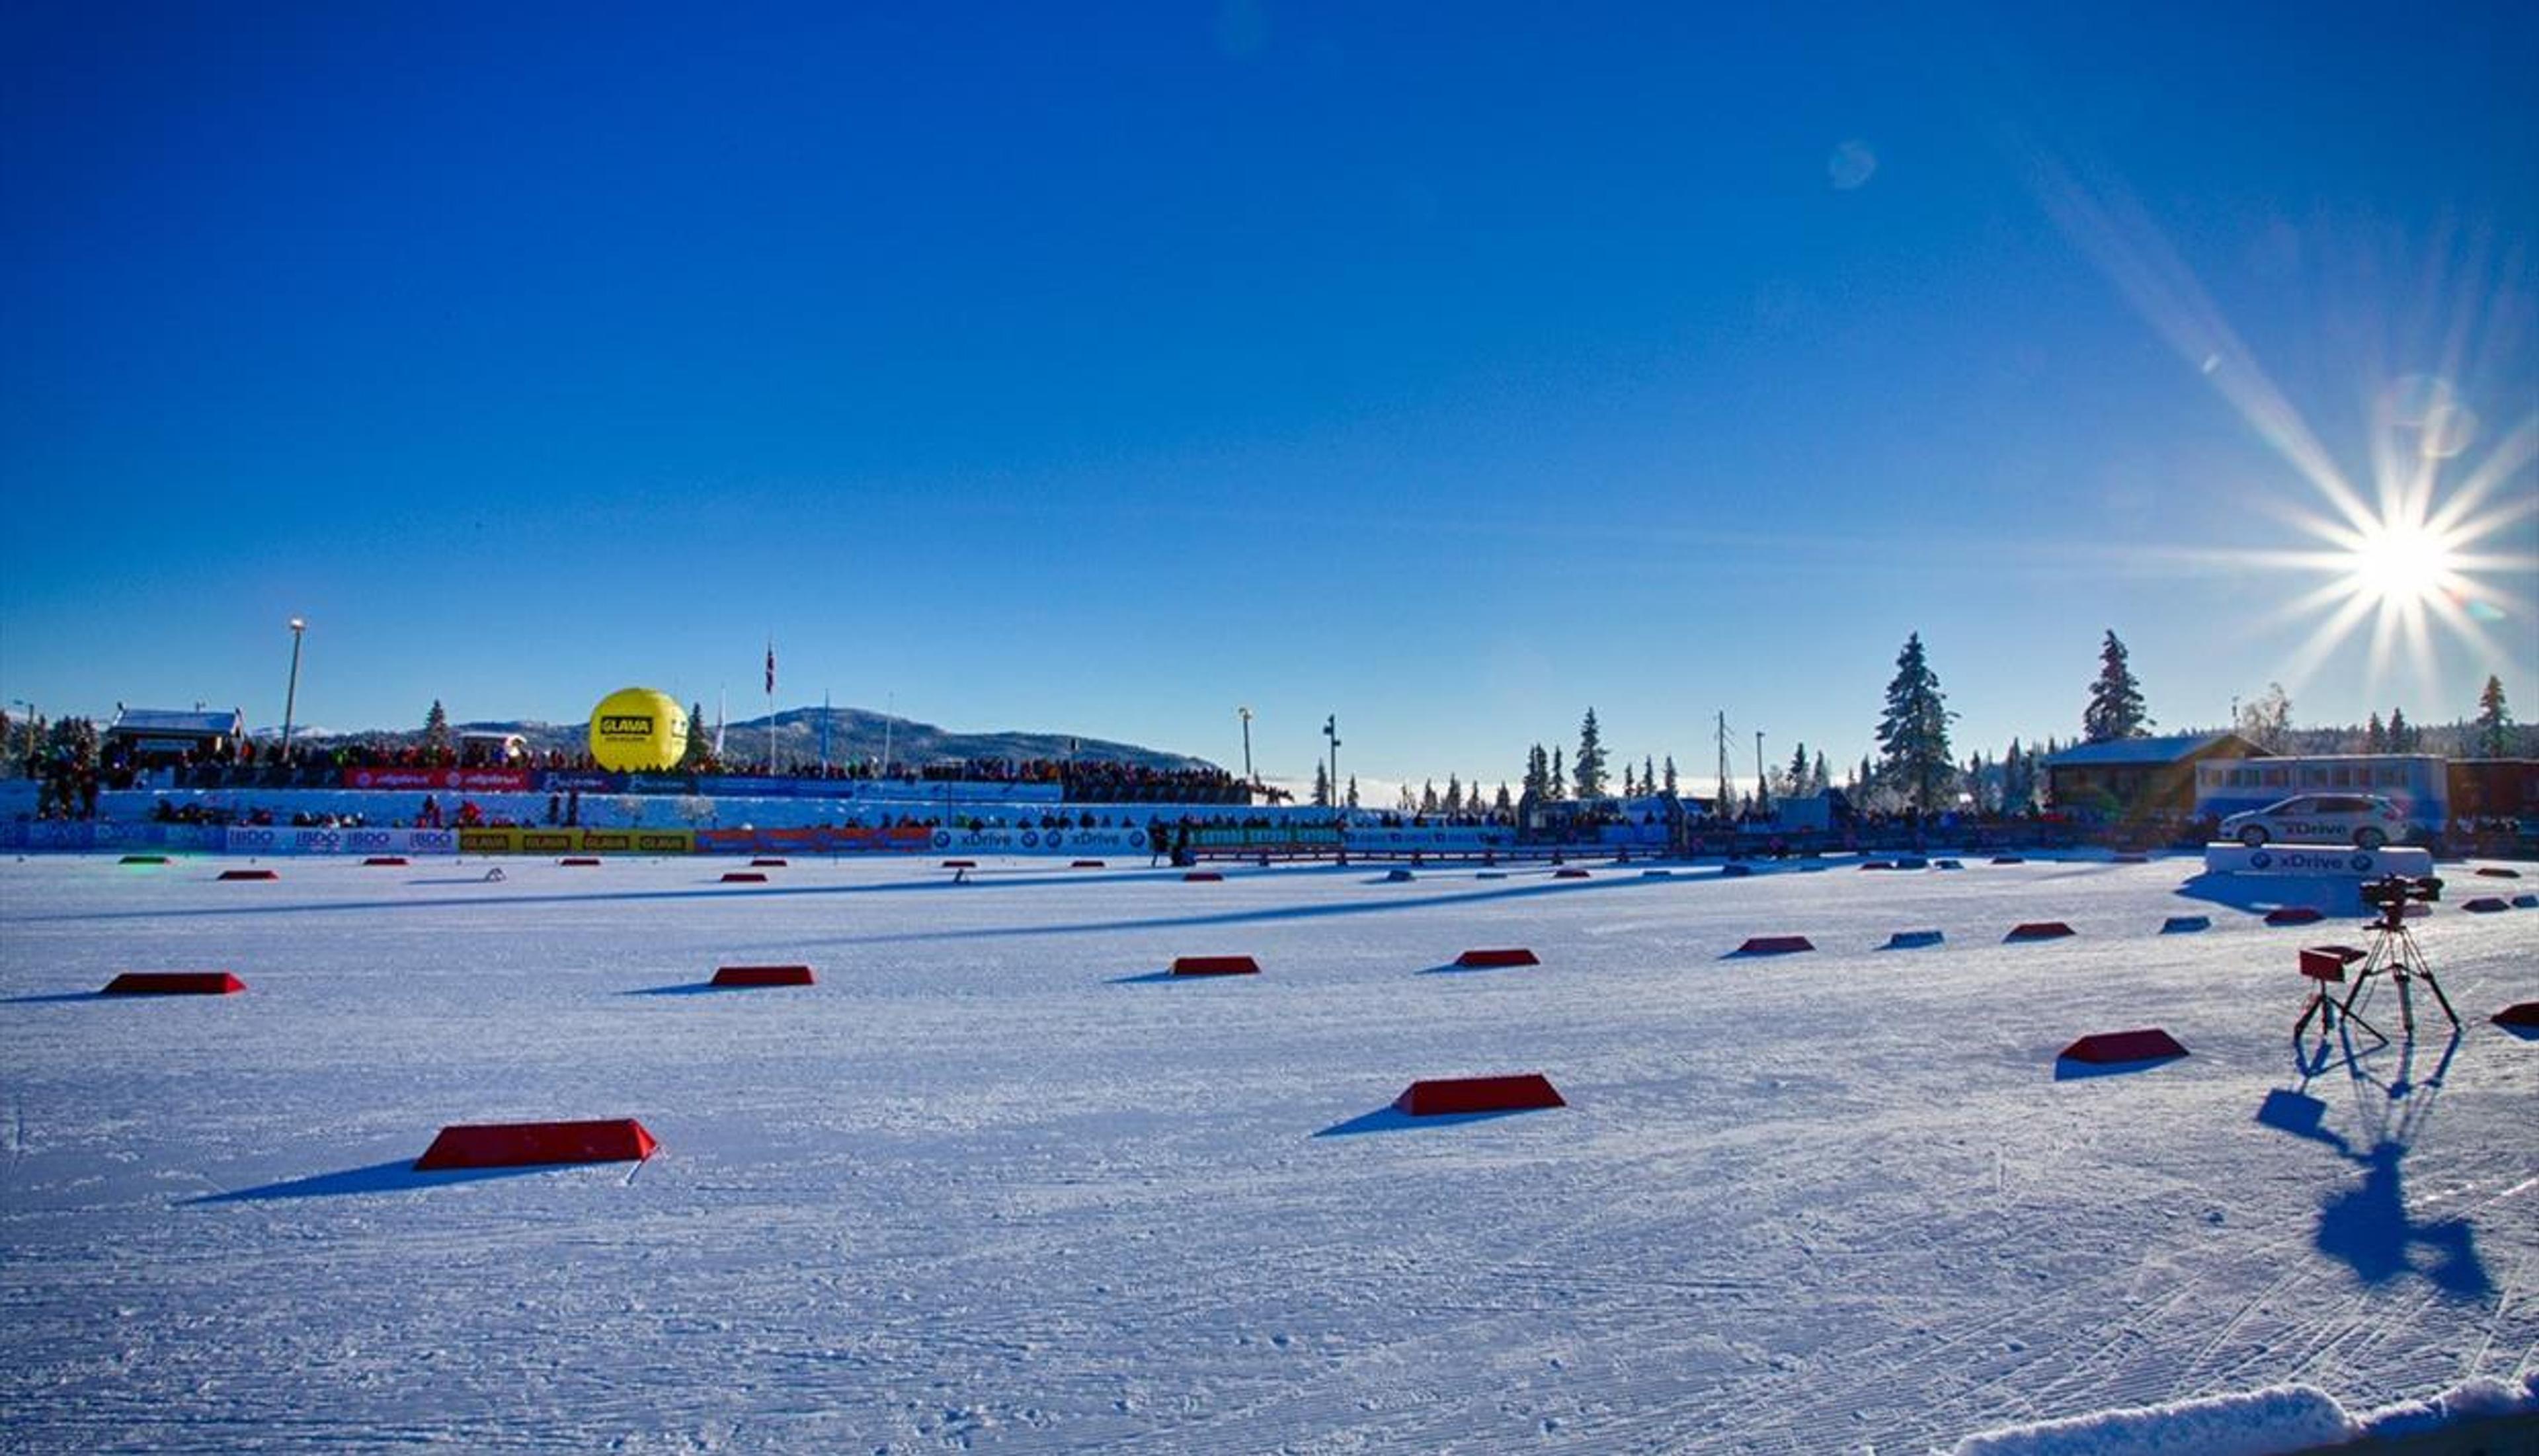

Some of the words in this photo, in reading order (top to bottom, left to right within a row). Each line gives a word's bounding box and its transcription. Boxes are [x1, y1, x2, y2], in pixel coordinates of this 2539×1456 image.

[602, 719, 649, 733] GLAVA
[2286, 821, 2345, 834] xDrive
[961, 831, 1012, 846] xDrive
[1070, 831, 1119, 846] xDrive
[2280, 853, 2343, 869] xDrive
